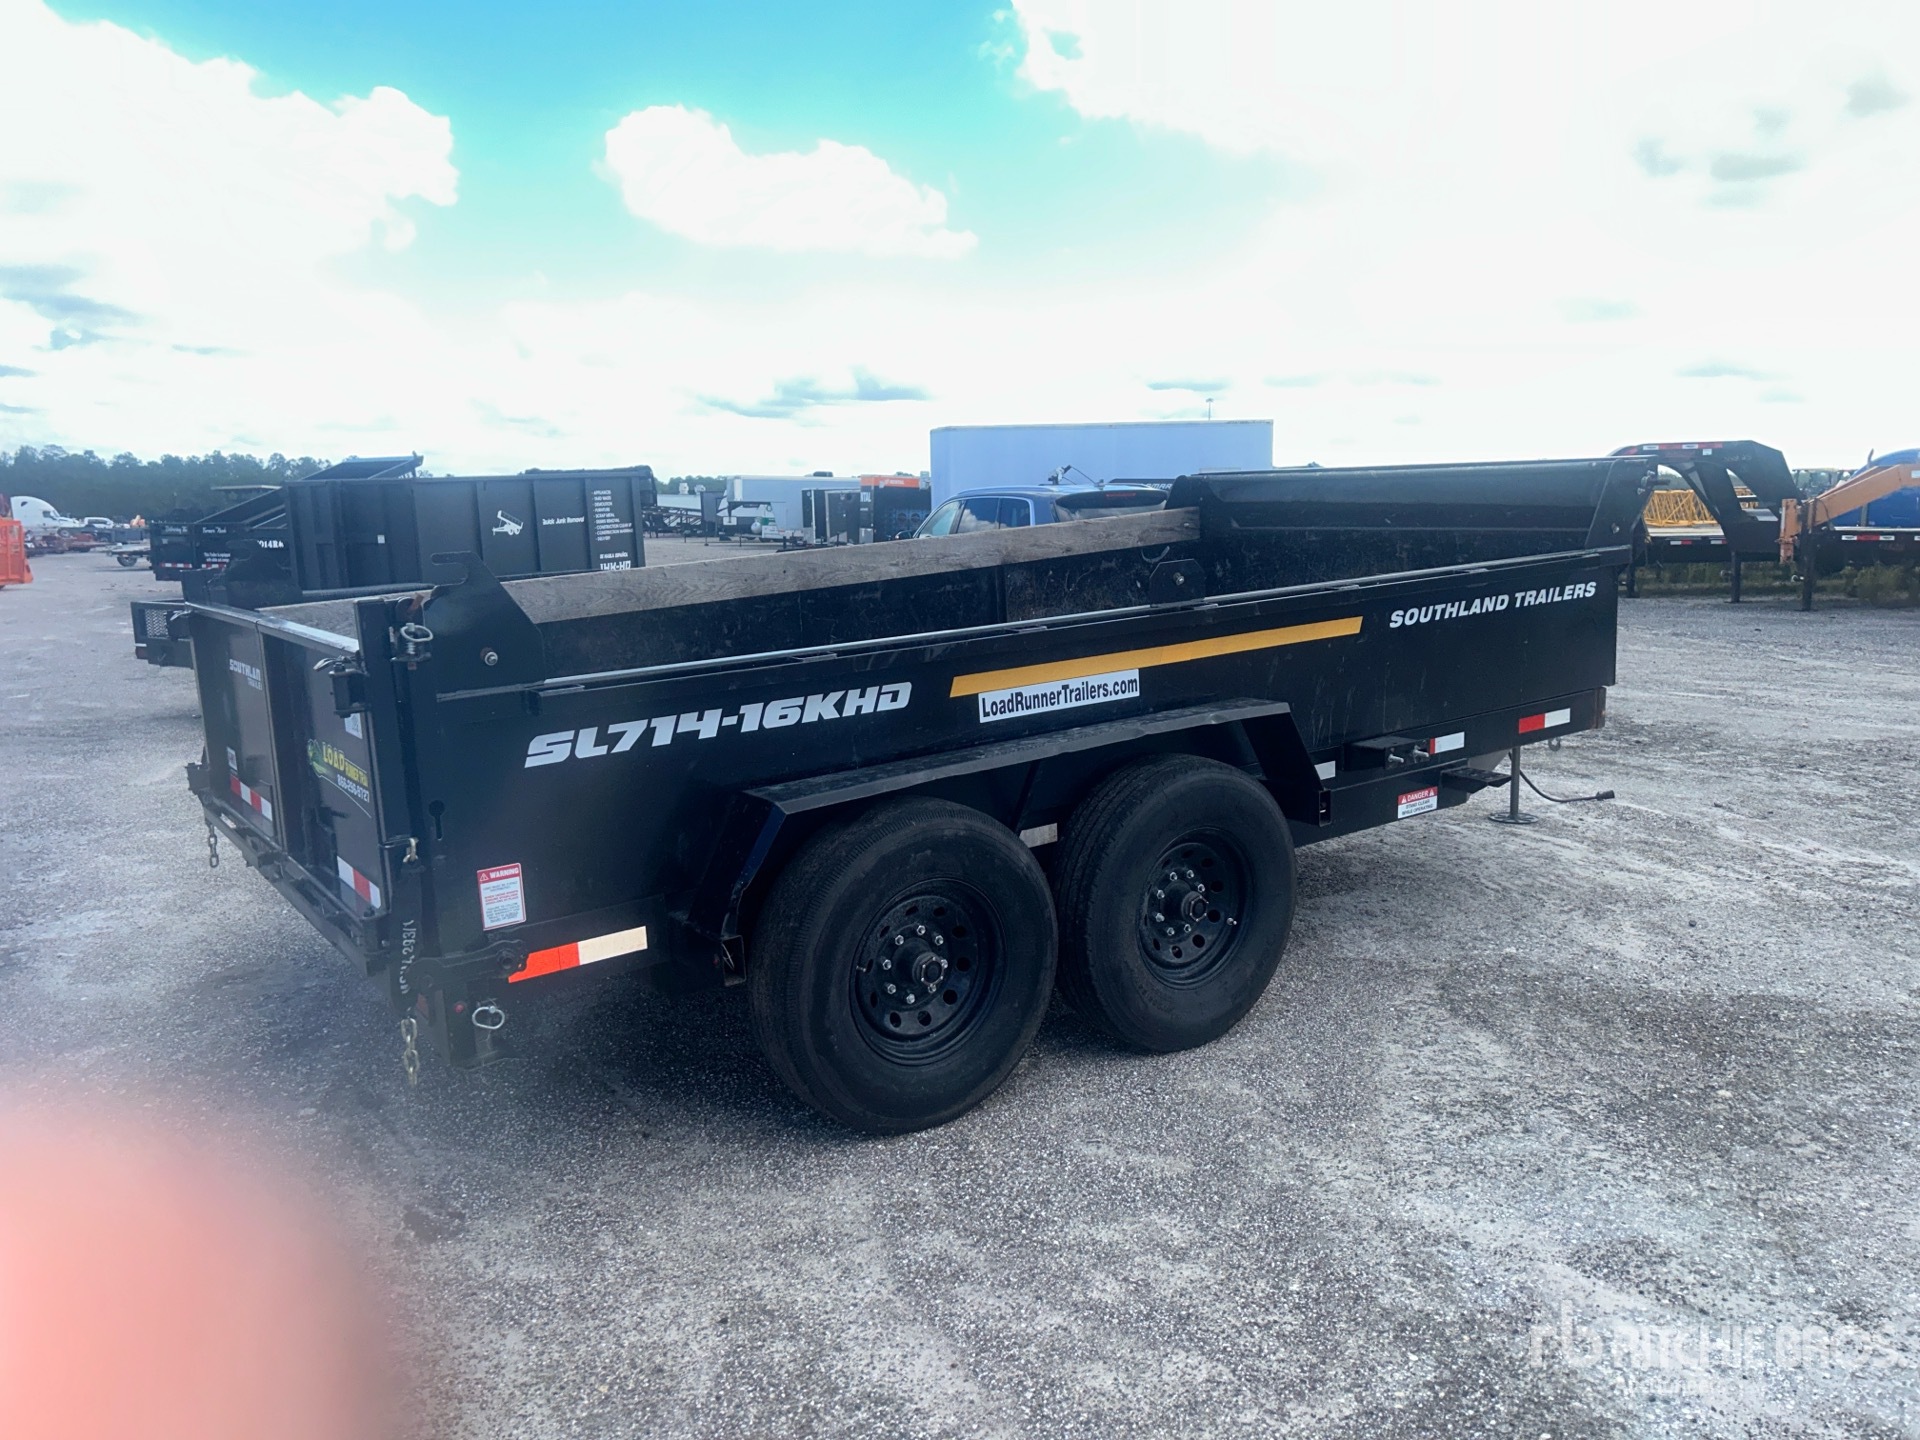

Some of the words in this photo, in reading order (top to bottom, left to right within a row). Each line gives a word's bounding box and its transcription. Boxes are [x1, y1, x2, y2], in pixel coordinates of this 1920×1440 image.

[1389, 594, 1509, 628] SOUTHLAND
[1514, 582, 1597, 608] TRAILERS
[982, 678, 1138, 718] LoadRunnerTrailers.com
[525, 682, 912, 768] SL714-16KHD
[322, 742, 344, 771] LOAD
[1407, 790, 1428, 802] DANGER
[490, 867, 518, 878] WARNING
